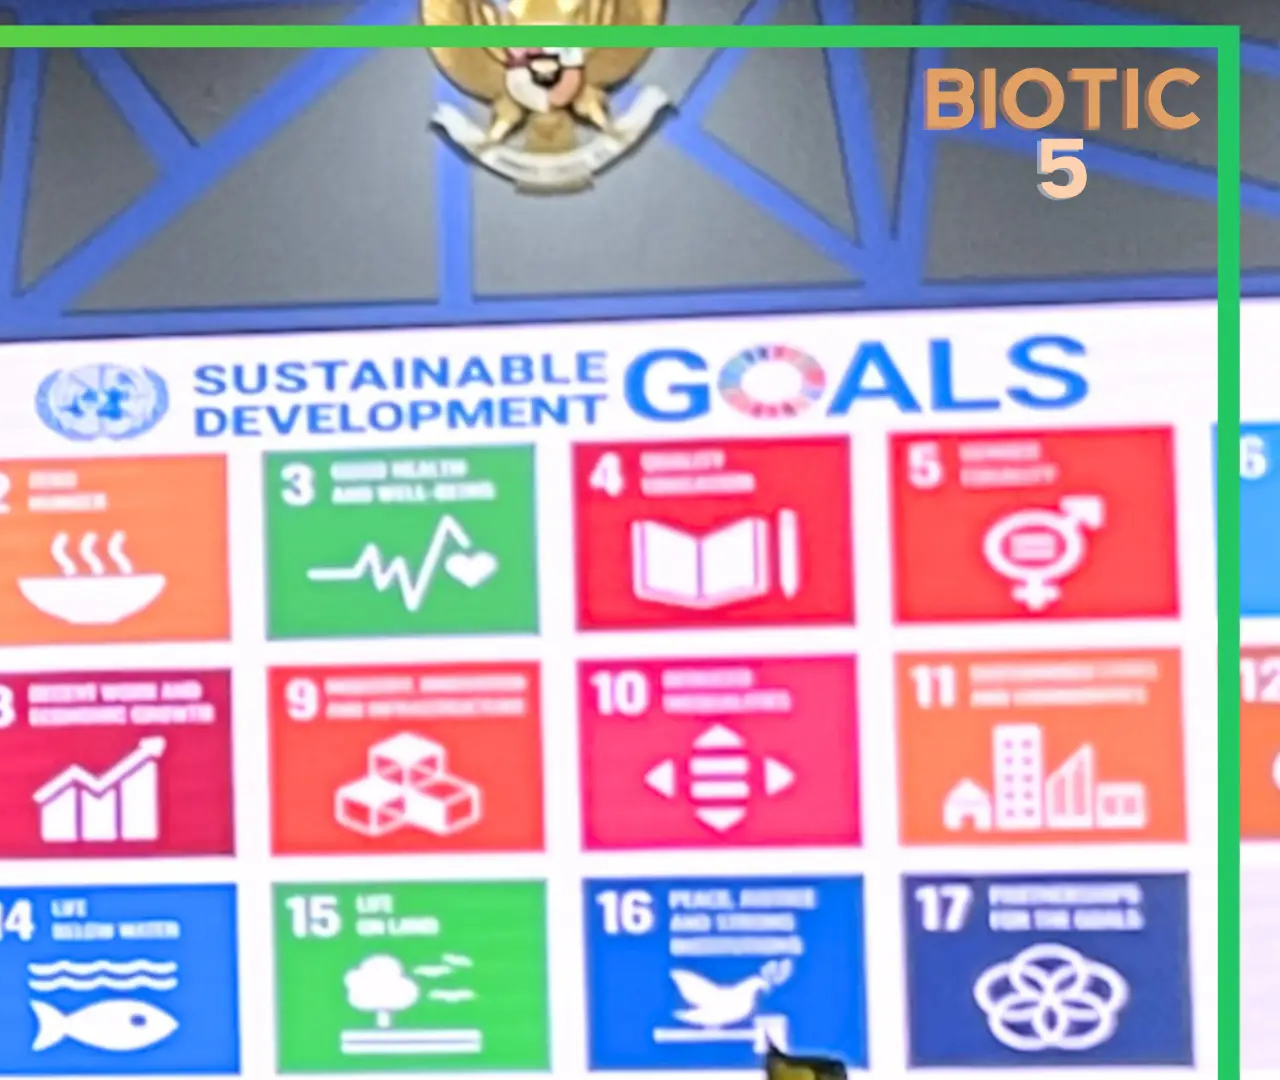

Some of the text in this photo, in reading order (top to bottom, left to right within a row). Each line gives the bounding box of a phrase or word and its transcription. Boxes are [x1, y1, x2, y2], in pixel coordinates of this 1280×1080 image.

[192, 351, 609, 396] SUSTAINABLE
[623, 333, 1090, 423] GOALS
[193, 394, 609, 438] DEVELOPMENT
[589, 451, 623, 497] 4
[908, 440, 943, 490] 5
[1240, 434, 1266, 479] 6
[280, 461, 315, 507] 3
[285, 677, 319, 722] 9
[590, 669, 648, 716] 10
[910, 664, 955, 709] 11
[285, 895, 342, 939] 15
[596, 889, 654, 935] 16
[915, 885, 974, 932] 17
